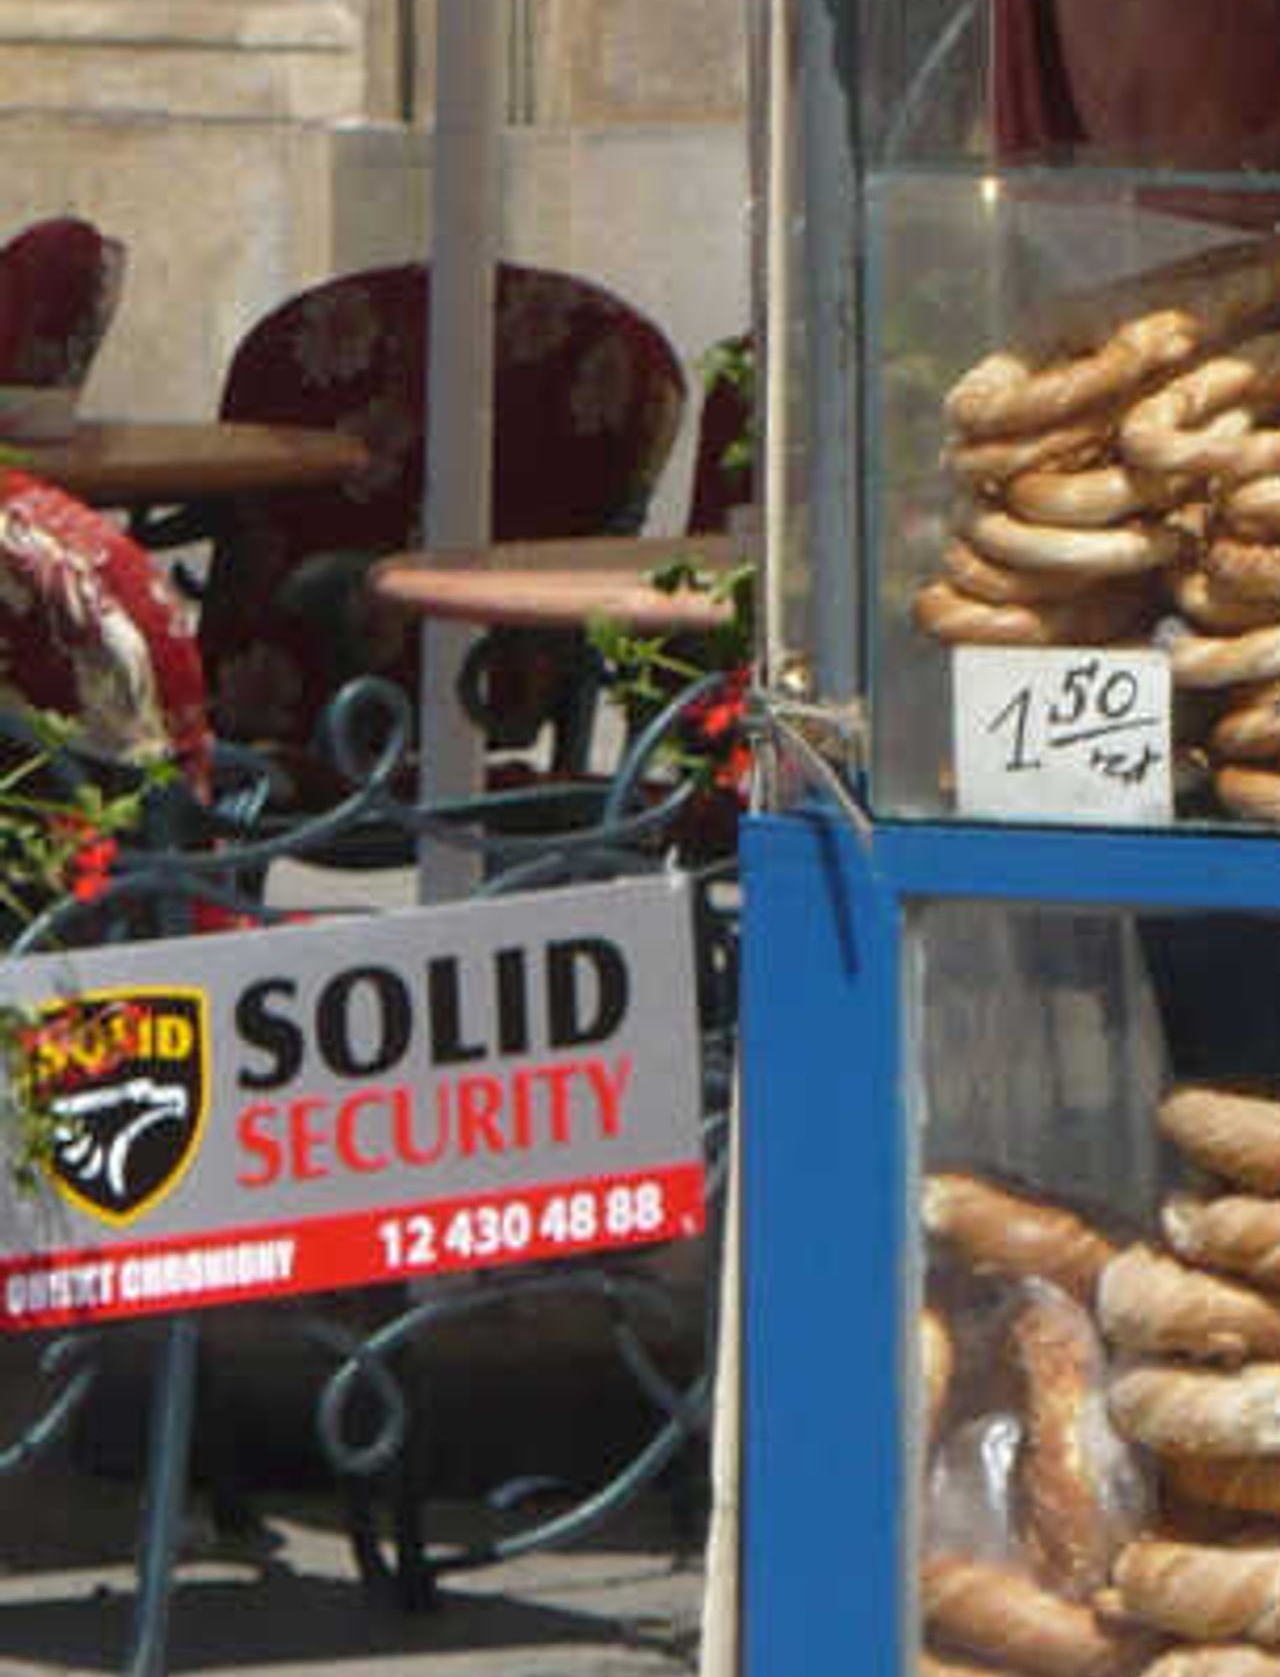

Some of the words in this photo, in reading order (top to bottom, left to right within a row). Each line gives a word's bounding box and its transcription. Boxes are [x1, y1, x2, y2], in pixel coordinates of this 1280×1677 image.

[233, 935, 630, 1091] SOLID
[236, 1054, 634, 1189] SECURITY
[378, 1215, 437, 1269] 12
[443, 1199, 532, 1259] 430
[538, 1190, 598, 1244] 48
[604, 1180, 665, 1237] 88
